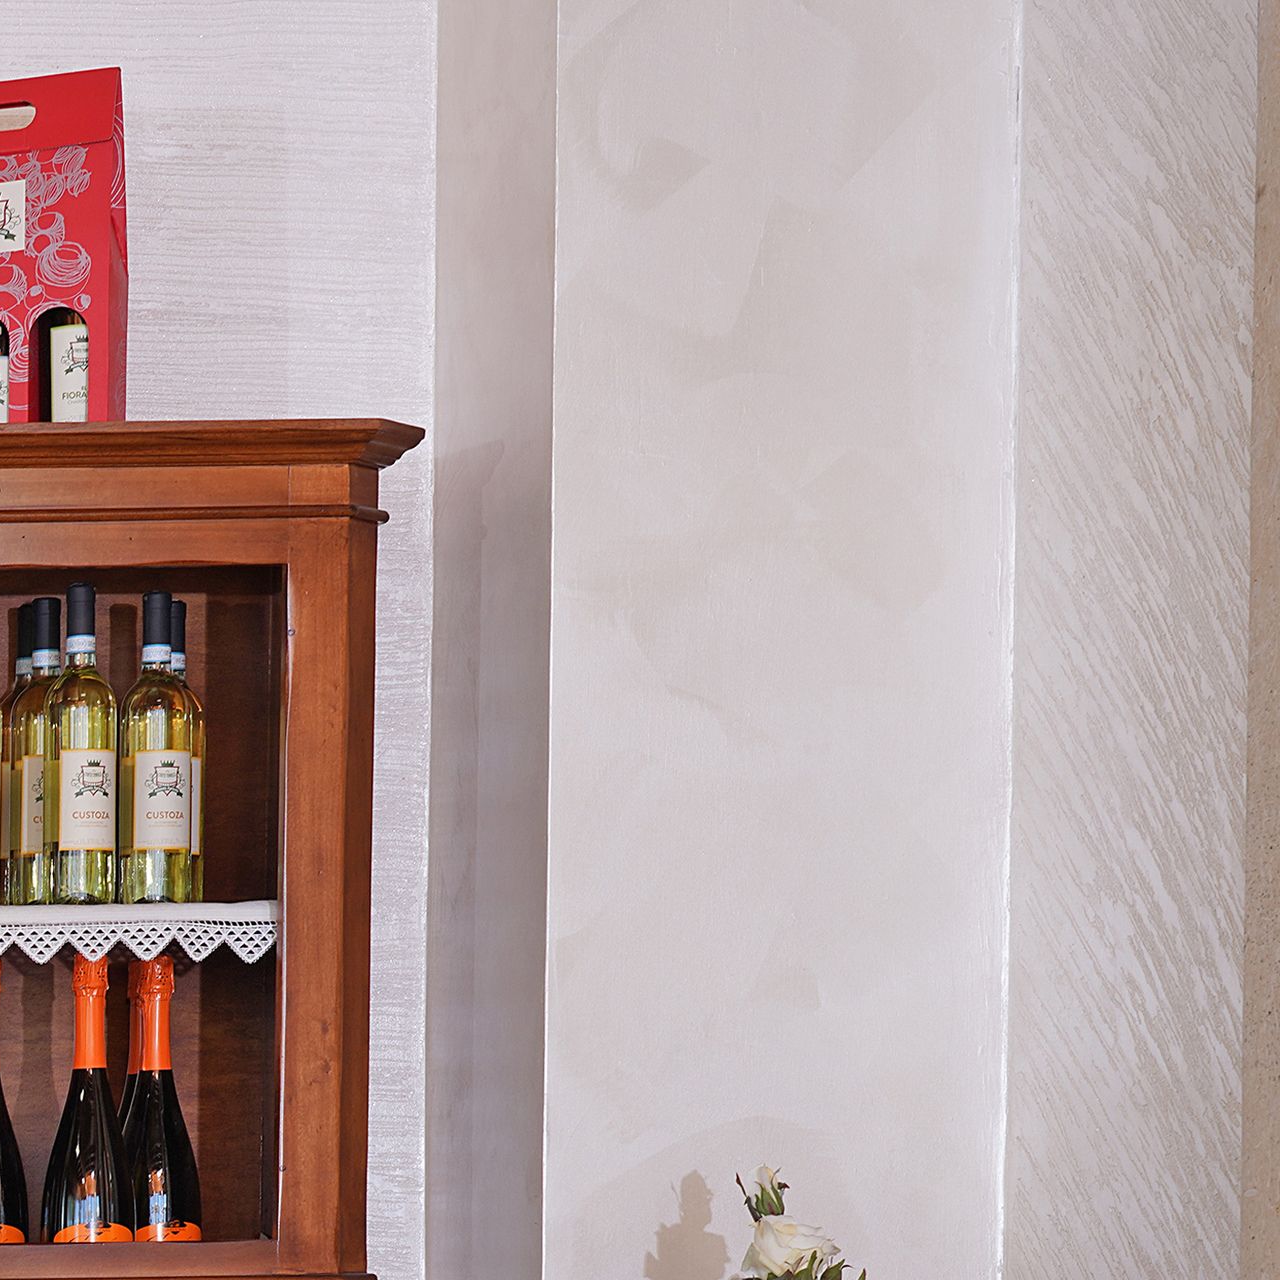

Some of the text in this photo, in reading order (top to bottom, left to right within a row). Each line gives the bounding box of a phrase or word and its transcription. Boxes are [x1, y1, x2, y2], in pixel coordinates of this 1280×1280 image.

[62, 392, 88, 400] FIORA
[72, 811, 111, 820] CUSTOZA
[146, 811, 185, 820] CUSTOZA
